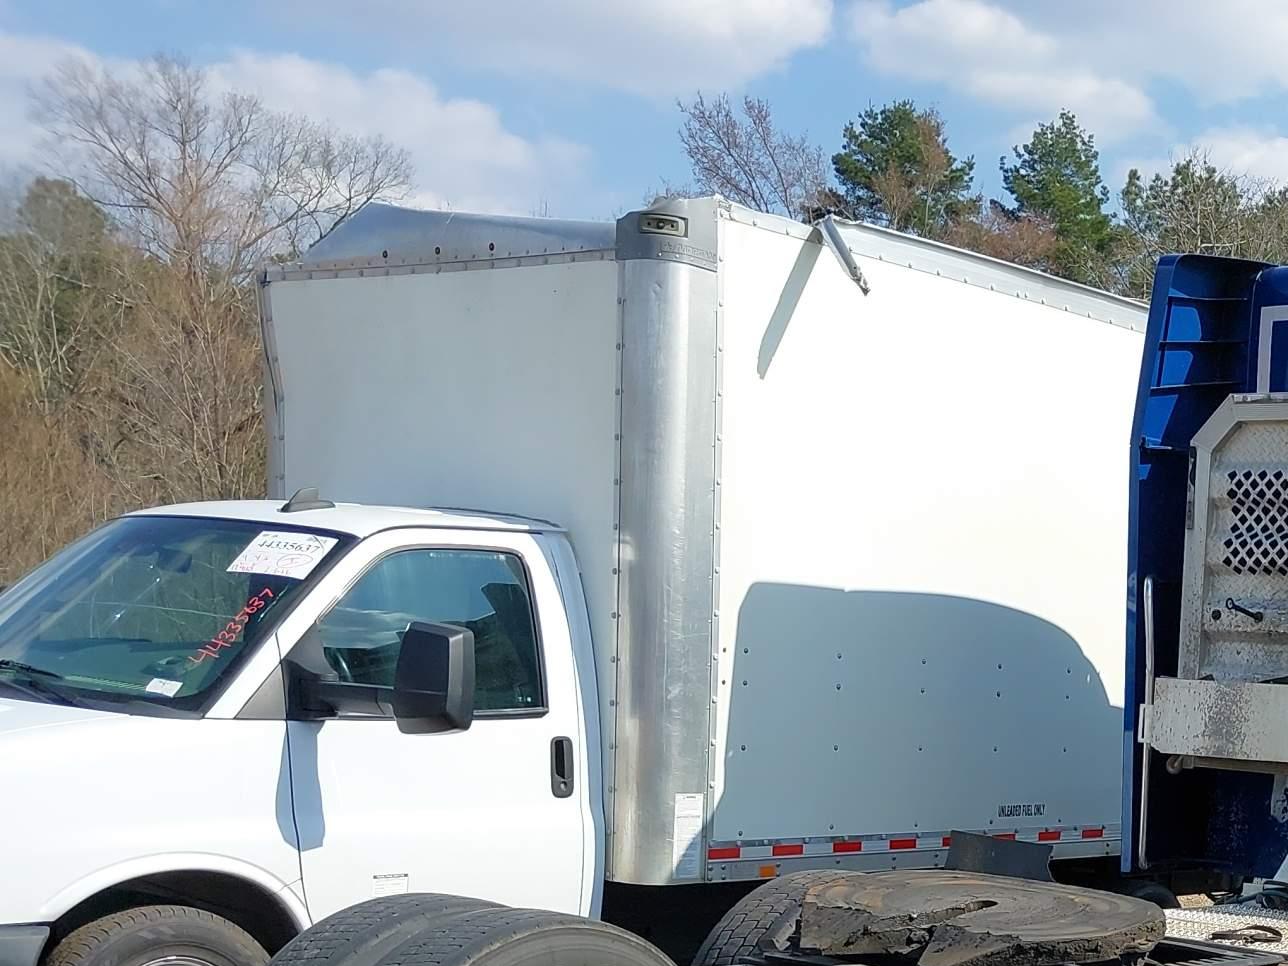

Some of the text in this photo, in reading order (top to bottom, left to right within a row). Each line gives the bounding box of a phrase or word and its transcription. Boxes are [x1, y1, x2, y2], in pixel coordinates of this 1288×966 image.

[189, 588, 274, 663] 44335637
[998, 804, 1045, 817] UNLEADED FUEL ONLY
